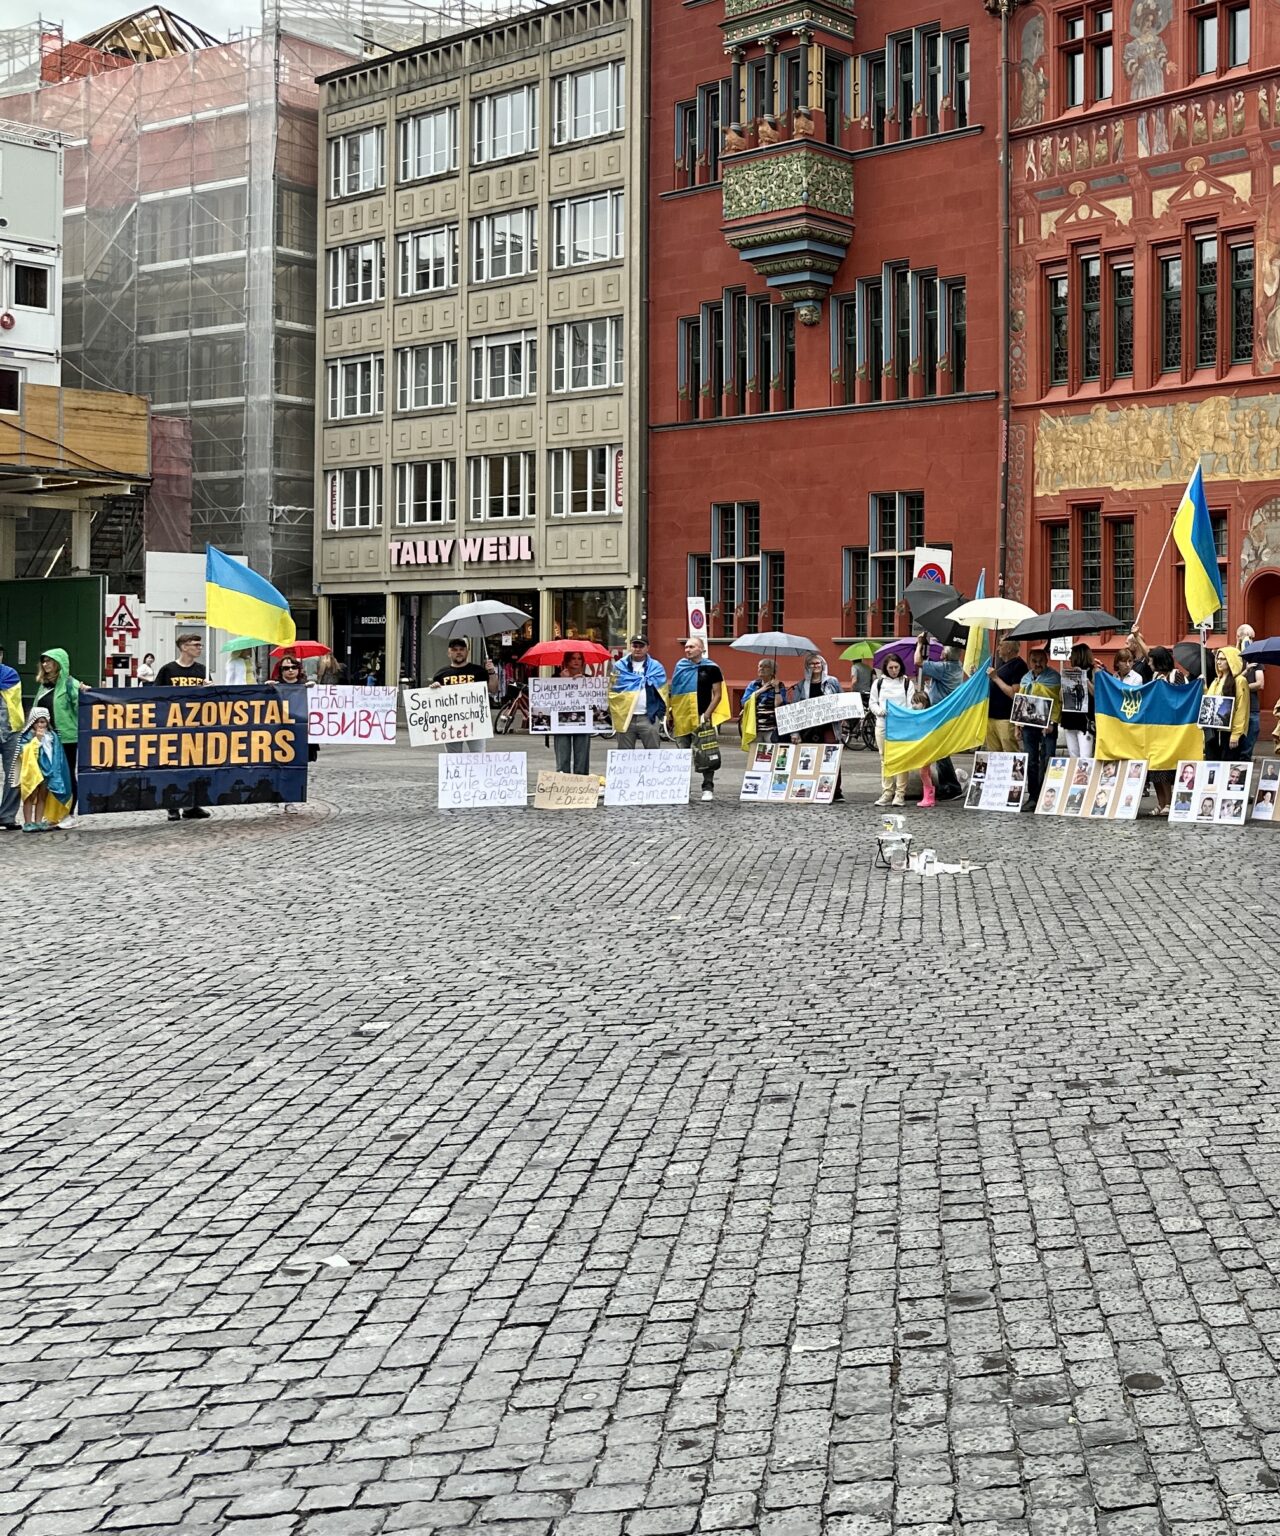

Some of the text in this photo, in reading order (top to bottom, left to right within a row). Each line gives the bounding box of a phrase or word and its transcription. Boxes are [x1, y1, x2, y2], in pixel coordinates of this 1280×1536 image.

[388, 539, 455, 565] TALLY
[170, 677, 204, 687] FREE
[443, 675, 475, 686] FREE
[317, 685, 338, 696] НЕ
[410, 692, 432, 711] Sei
[435, 693, 459, 709] nicht
[461, 686, 488, 707] ruhig!
[310, 696, 355, 710] ПОЛОН
[91, 700, 296, 730] FREE AZOVSTAL
[409, 704, 489, 732] Gefangenschaft
[308, 710, 397, 741] ВБИВАЄ
[90, 730, 296, 769] DEFENDERS
[610, 751, 653, 764] Freiheit
[485, 760, 524, 778] illegal
[441, 780, 480, 792] zivile
[610, 776, 630, 790] das
[618, 784, 688, 803] Regiment!
